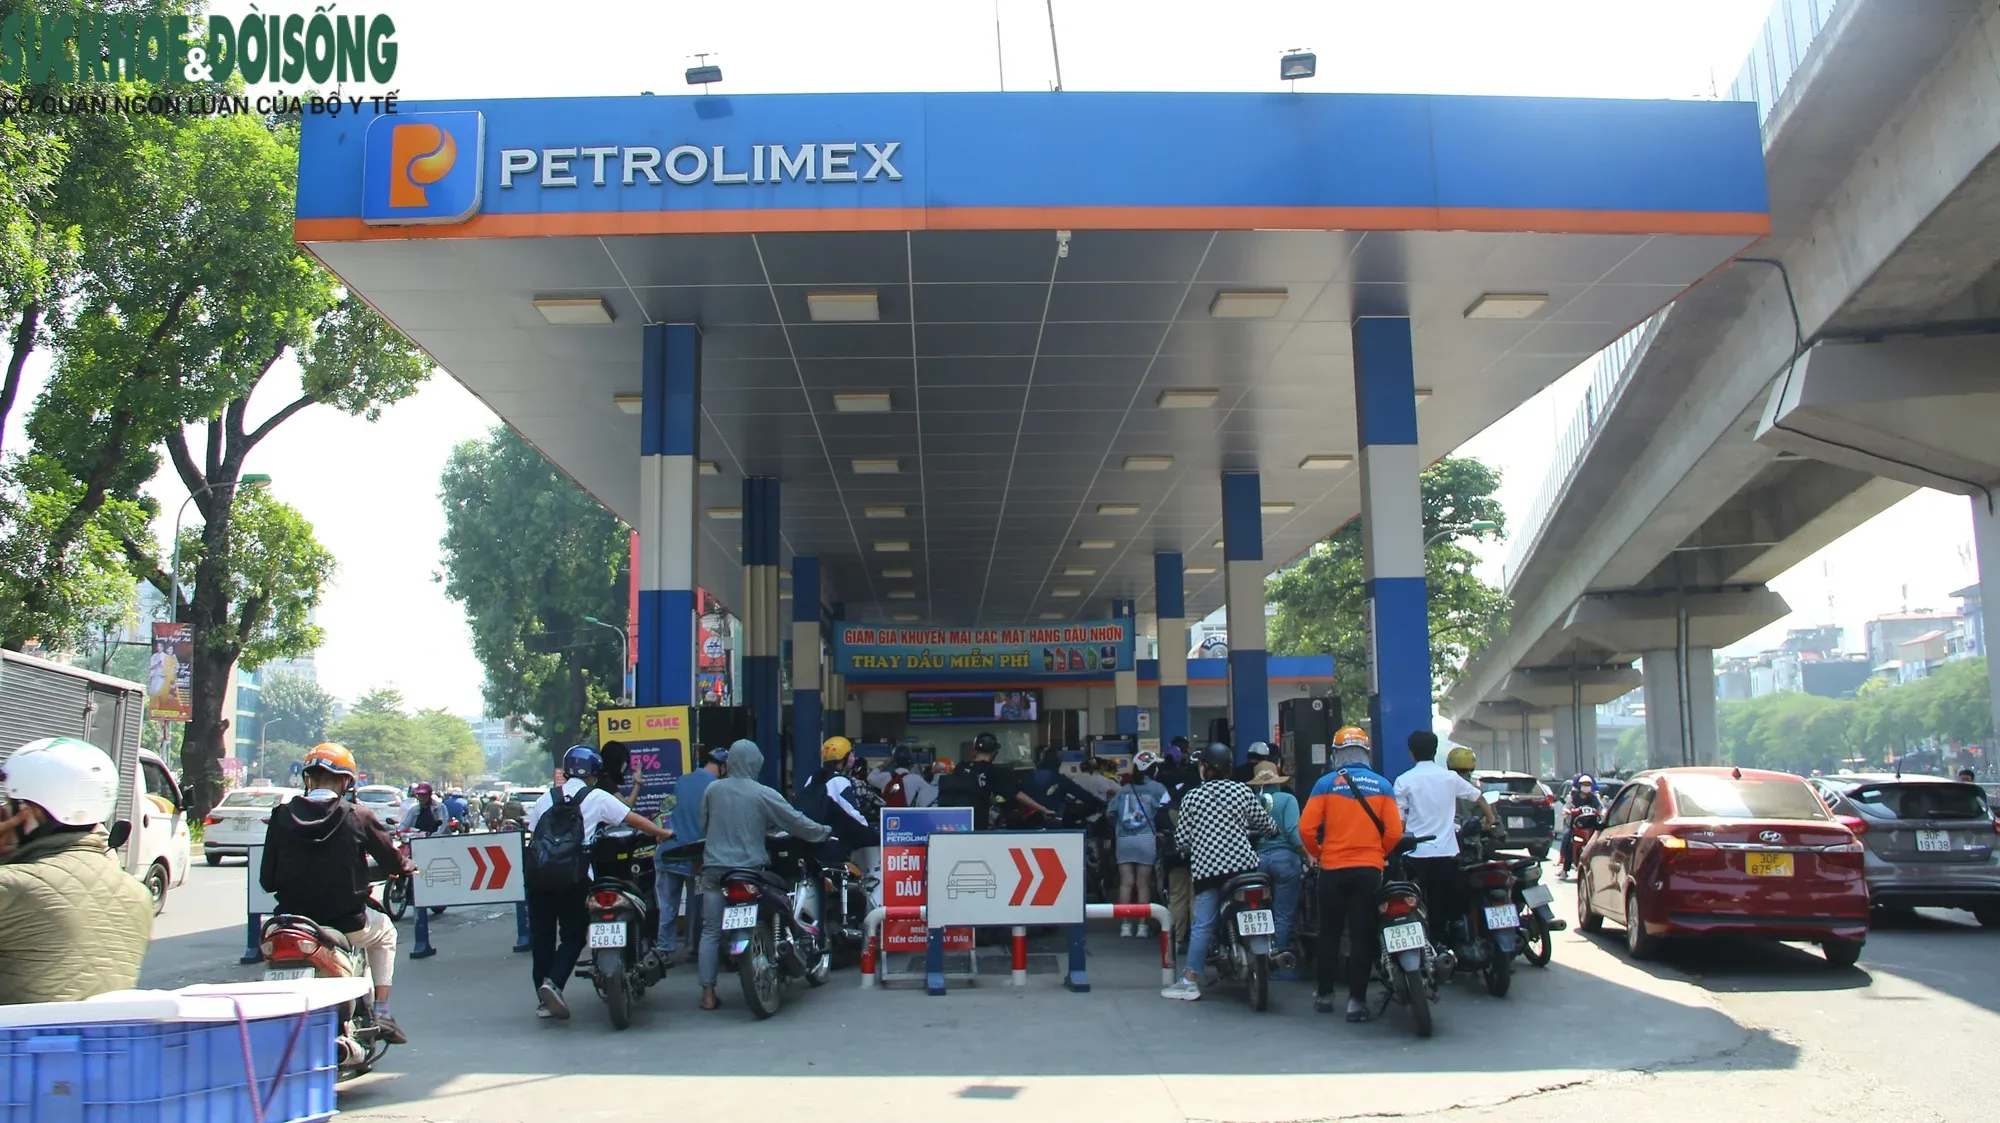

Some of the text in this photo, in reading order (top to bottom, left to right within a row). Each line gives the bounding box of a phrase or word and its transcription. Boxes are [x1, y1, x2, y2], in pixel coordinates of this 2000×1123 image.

[500, 141, 903, 188] PETROLIMEX
[852, 654, 901, 668] THAY
[950, 648, 994, 668] MIỄN
[999, 650, 1029, 668] PHÍ
[608, 717, 631, 731] be
[646, 716, 680, 728] CAKE
[887, 849, 920, 871] ĐIỂM
[1760, 853, 1779, 864] 30F
[595, 924, 621, 935] 29-AA
[591, 935, 624, 946] 548.43
